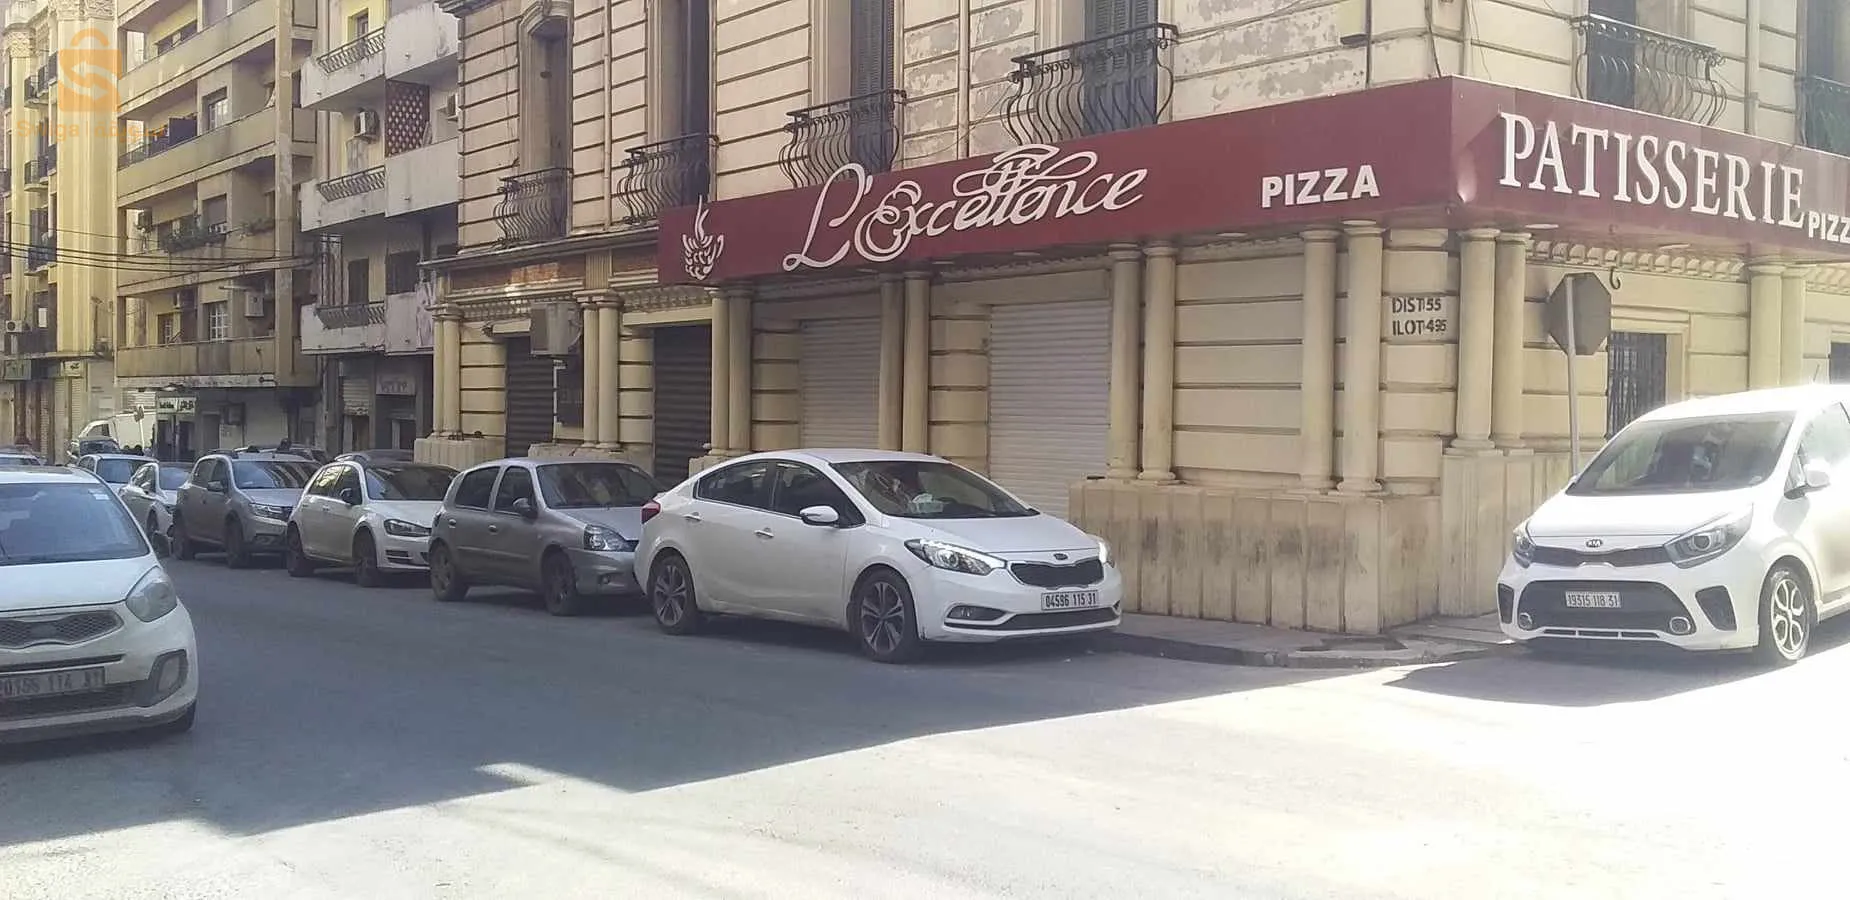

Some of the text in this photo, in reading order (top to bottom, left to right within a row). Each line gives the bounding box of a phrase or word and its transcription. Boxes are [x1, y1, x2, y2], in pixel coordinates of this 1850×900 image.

[1261, 164, 1380, 208] PIZZA
[1498, 111, 1806, 229] PATISSERIE
[1073, 593, 1086, 606] 115
